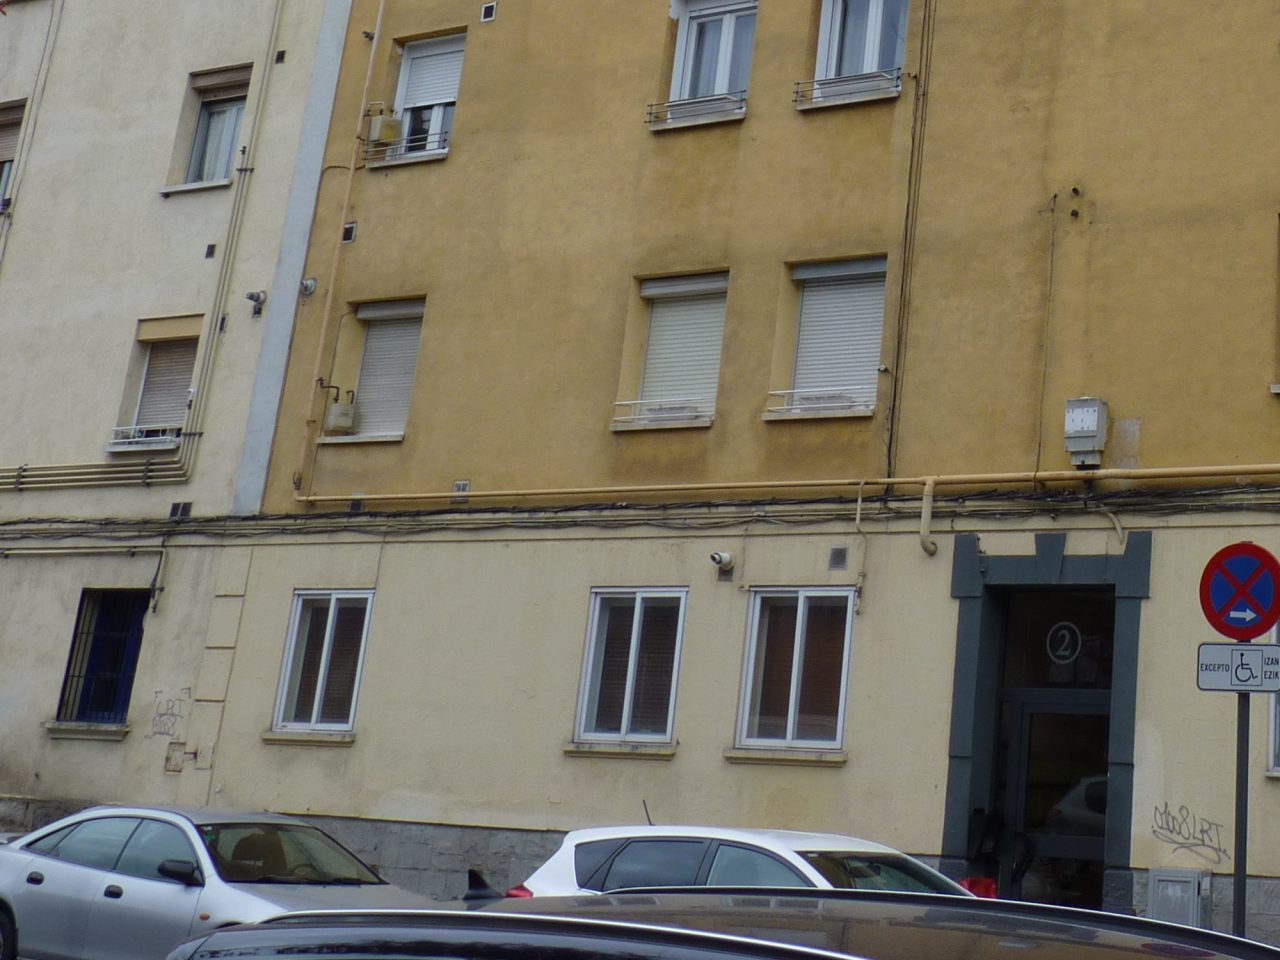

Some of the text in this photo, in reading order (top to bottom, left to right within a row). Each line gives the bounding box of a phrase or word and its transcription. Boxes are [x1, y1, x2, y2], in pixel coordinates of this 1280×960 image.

[1056, 630, 1070, 655] 2
[1264, 657, 1279, 666] IZAN
[1200, 663, 1230, 672] EXCEPTO
[1264, 671, 1279, 679] EZIK
